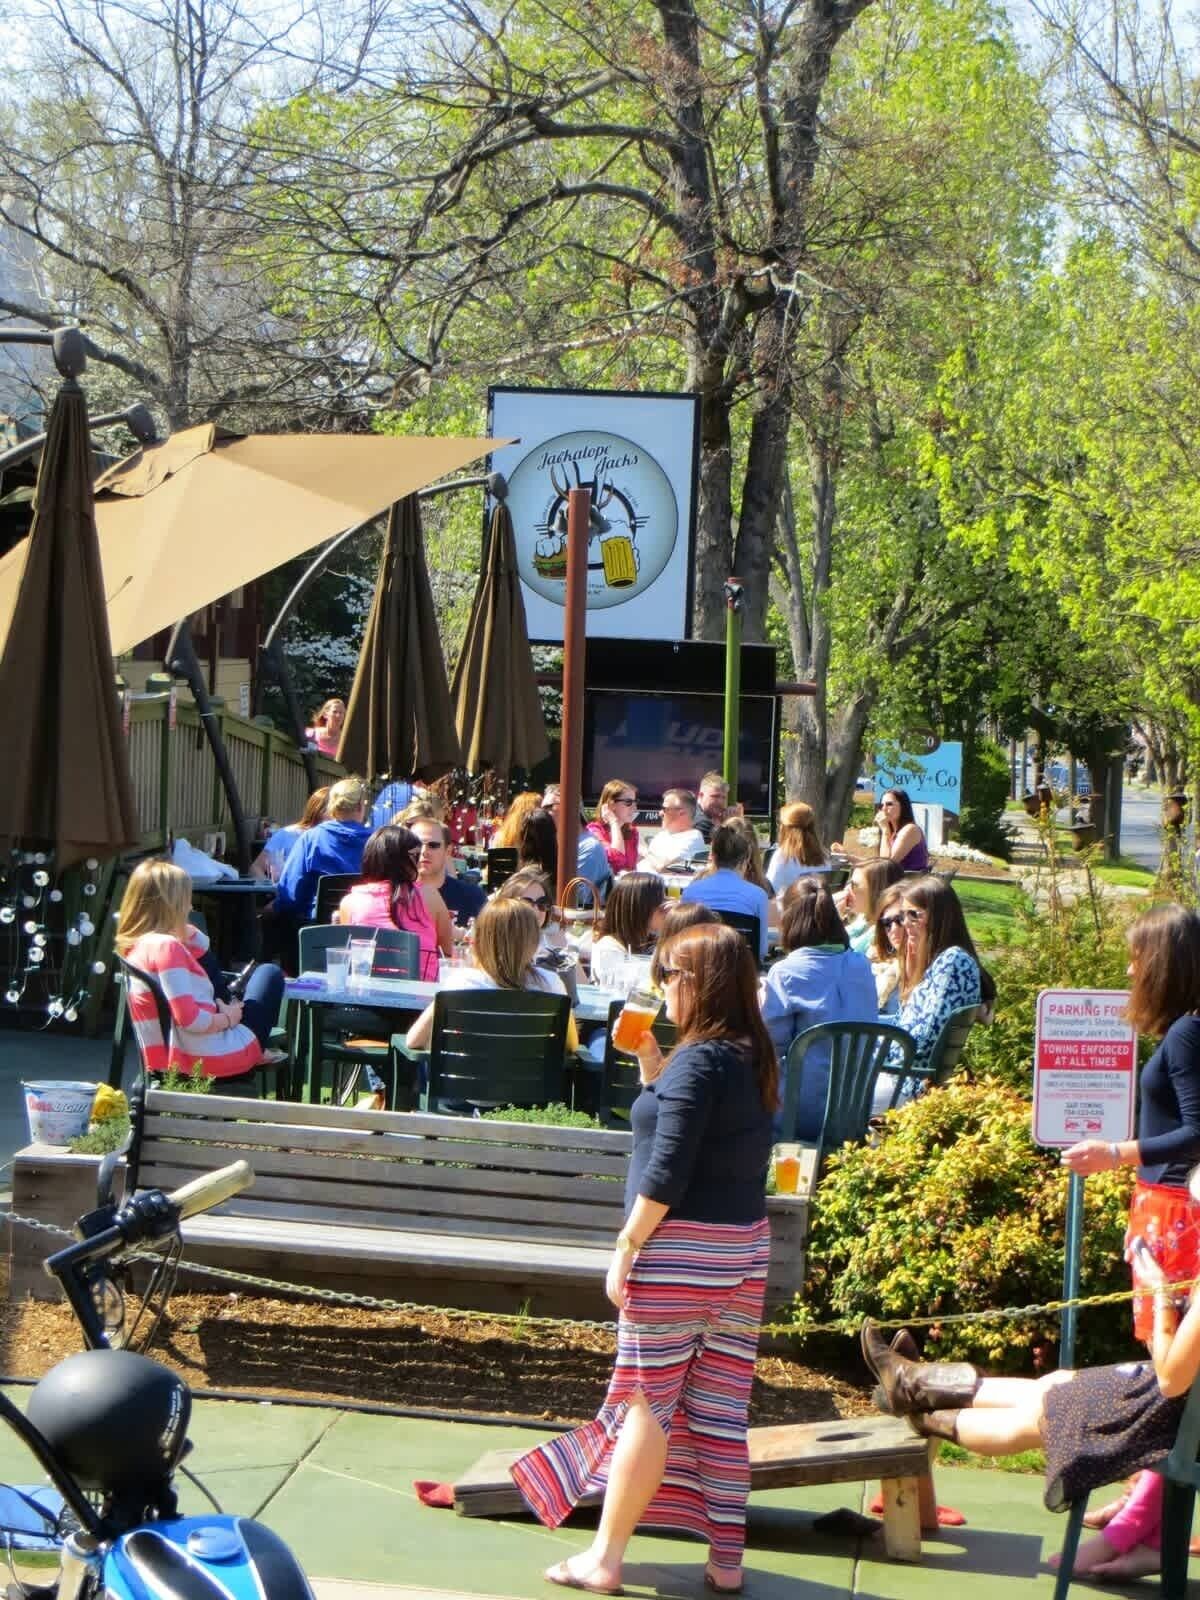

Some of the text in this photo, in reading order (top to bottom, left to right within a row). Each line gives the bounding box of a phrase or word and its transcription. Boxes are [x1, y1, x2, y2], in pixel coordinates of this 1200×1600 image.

[594, 453, 638, 474] Jacks
[1049, 1004, 1100, 1016] PARKING
[1043, 1044, 1129, 1055] TOWING ENFORCED
[1054, 1056, 1117, 1067] AT ALL TIMES
